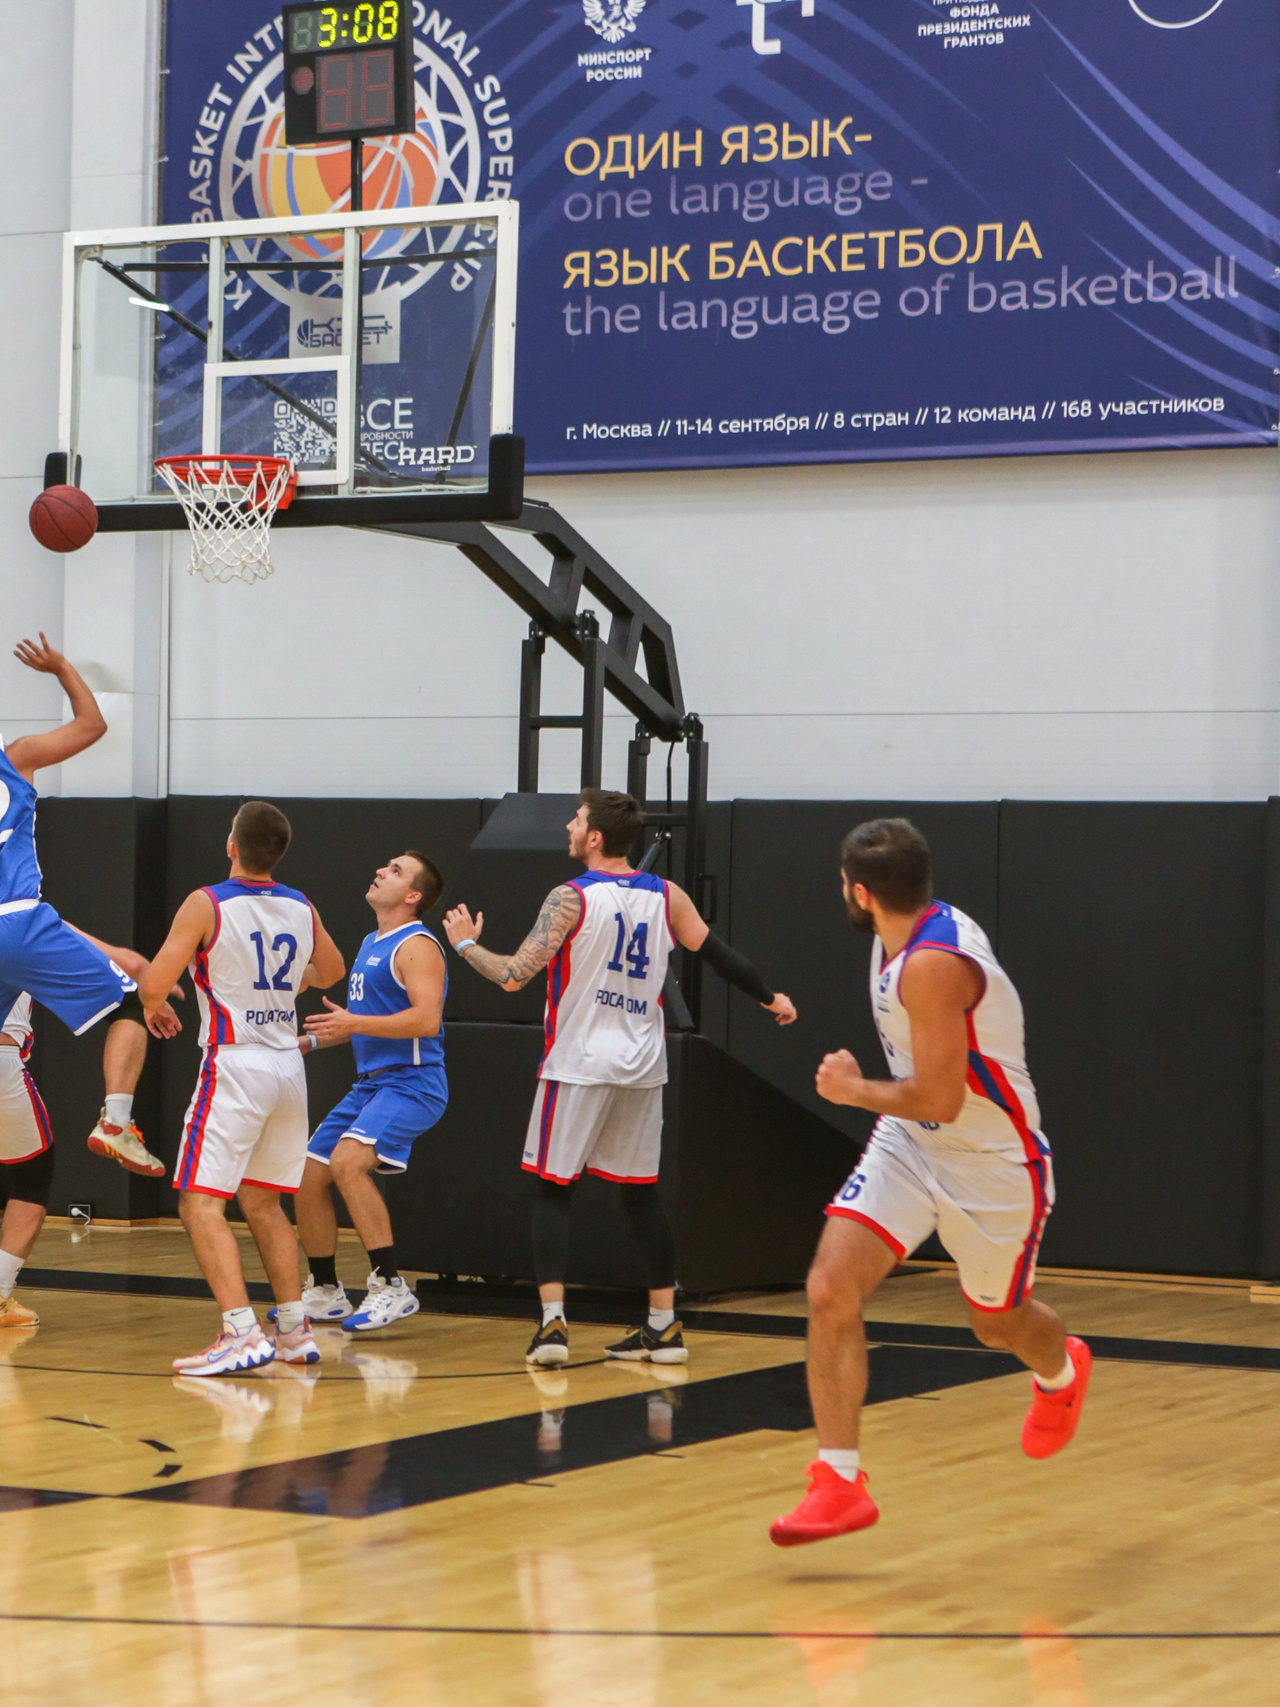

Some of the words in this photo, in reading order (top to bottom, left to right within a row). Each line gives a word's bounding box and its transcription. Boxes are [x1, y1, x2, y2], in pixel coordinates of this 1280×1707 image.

[318, 0, 399, 48] 3:08
[918, 14, 1031, 36] ПРЕЗИДЕНТСКИХ
[949, 3, 999, 18] ФОНДА
[577, 48, 652, 67] МИНСПОРТ
[944, 31, 1004, 48] ГРАНТОВ
[586, 65, 642, 82] РОССИИ
[474, 74, 514, 201] SUPER
[564, 129, 702, 181] ОДИН
[720, 116, 872, 165] ЯЗЫК-
[563, 187, 652, 222] one
[670, 169, 893, 222] language
[563, 243, 691, 289] ЯЗЫК
[709, 220, 1043, 281] БАСКЕТБОЛА
[562, 295, 641, 336] the
[659, 288, 880, 340] language
[898, 273, 956, 317] of
[967, 255, 1239, 313] basketball
[360, 430, 413, 442] РОБНОСТИ
[566, 427, 578, 440] г.
[583, 423, 653, 439] Москва
[676, 418, 713, 435] 11-14
[718, 413, 810, 436] сентября
[833, 411, 845, 428] 8
[850, 411, 910, 431] стран
[933, 406, 952, 424] 12
[957, 405, 1037, 423] команд
[1062, 400, 1092, 418] 168
[1098, 397, 1225, 420] участников
[398, 445, 475, 466] HARD
[250, 930, 298, 991] 12
[607, 912, 650, 979] 14
[349, 972, 365, 1001] 33
[594, 989, 648, 1016] РОСАОМ
